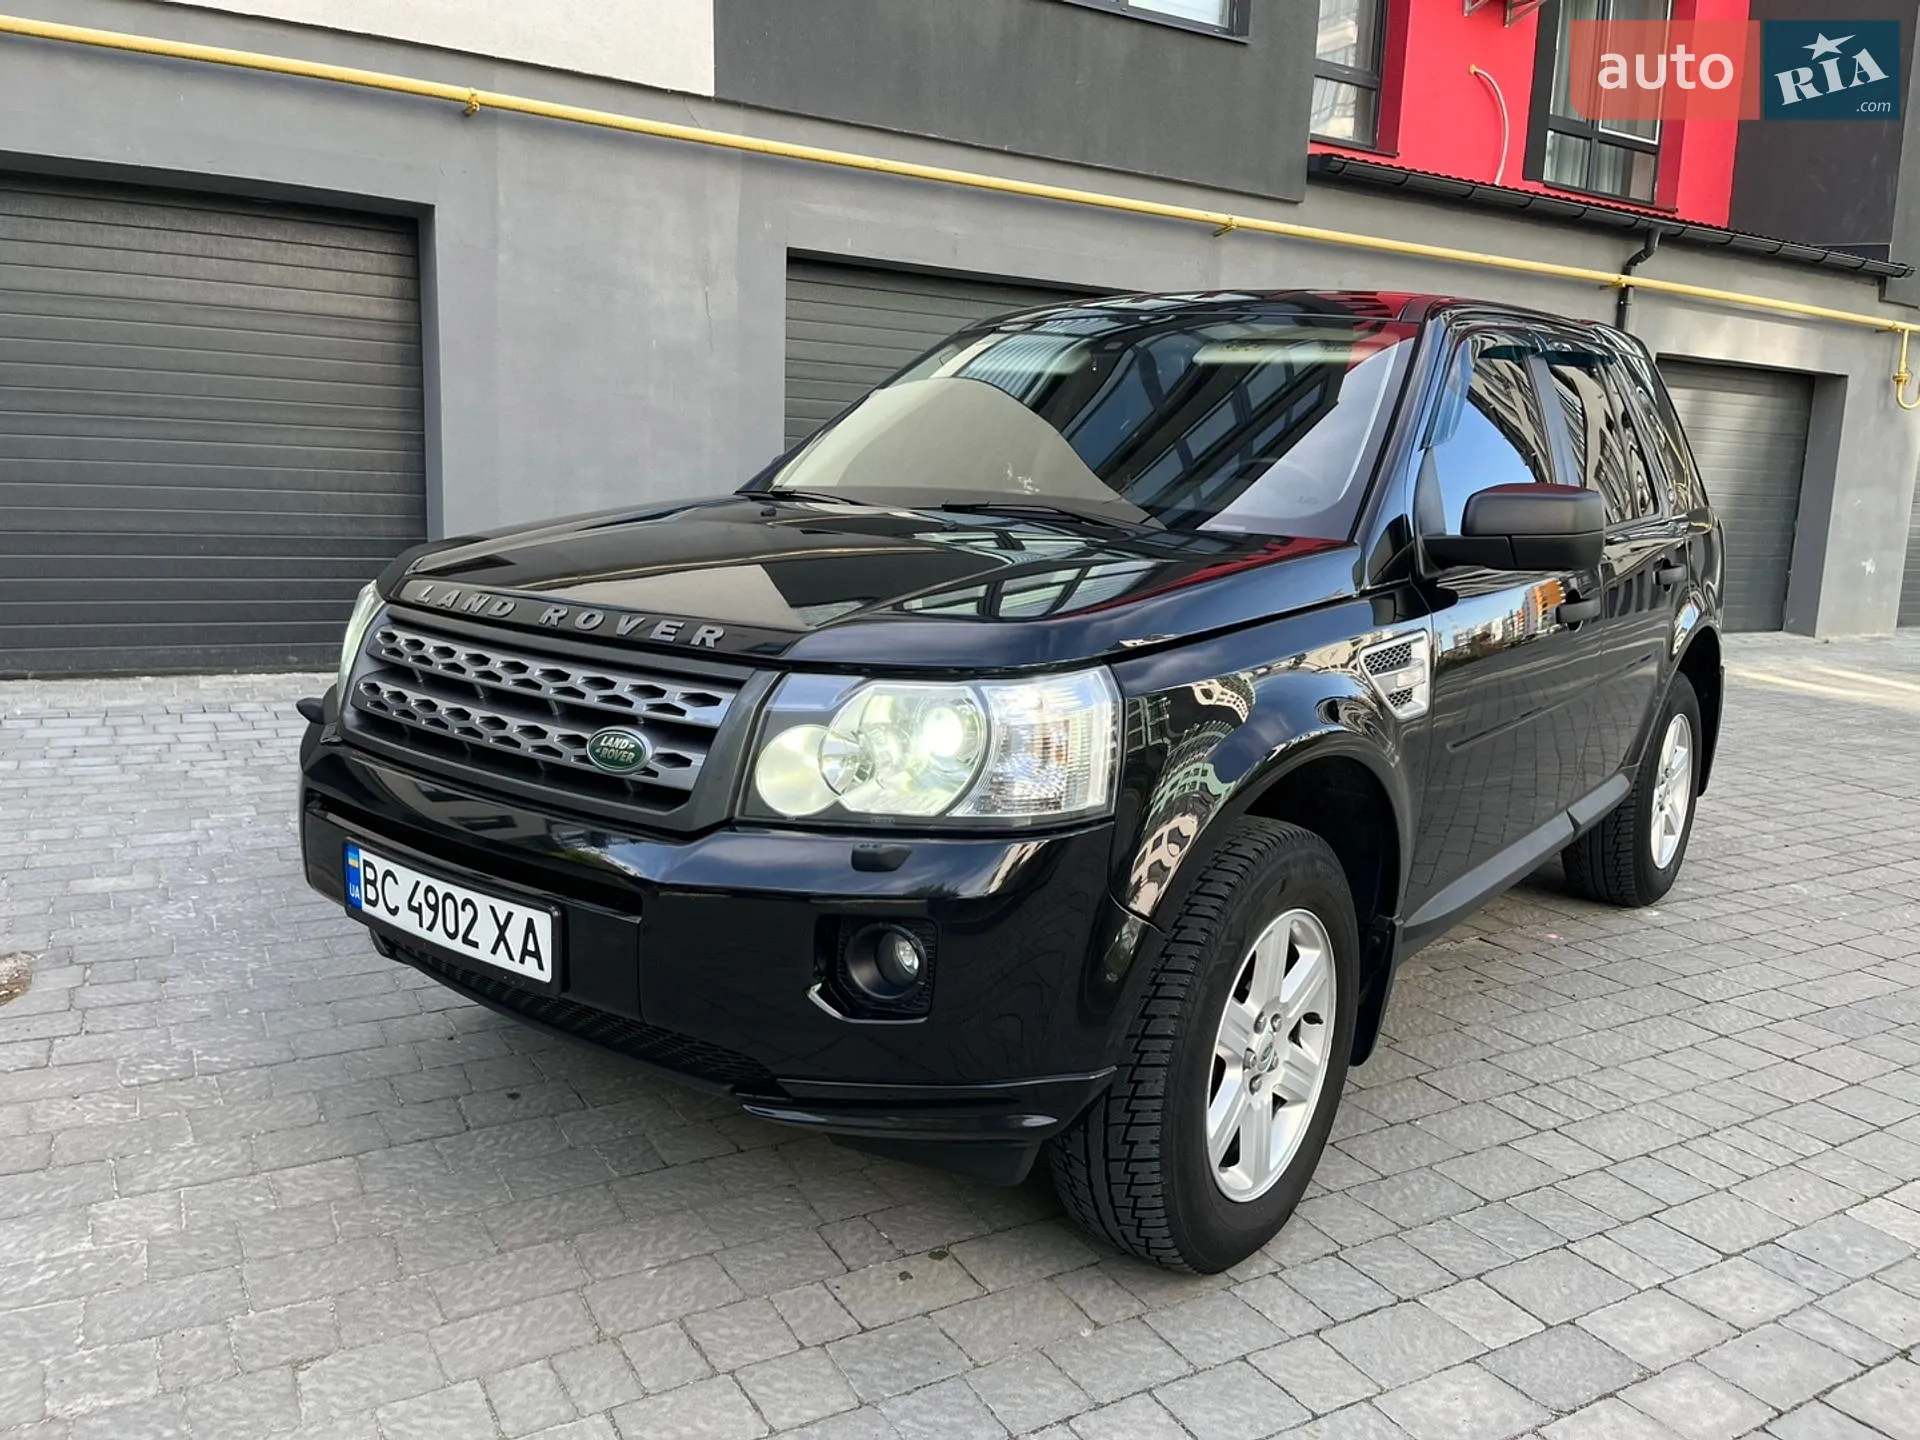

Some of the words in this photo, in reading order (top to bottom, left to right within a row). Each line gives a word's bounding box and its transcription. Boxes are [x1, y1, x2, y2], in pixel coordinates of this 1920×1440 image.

[415, 585, 517, 618] LAND
[539, 604, 726, 648] ROVER
[349, 882, 361, 900] UA
[362, 858, 400, 917] BC
[407, 880, 480, 949] 4902
[489, 904, 545, 972] XA
